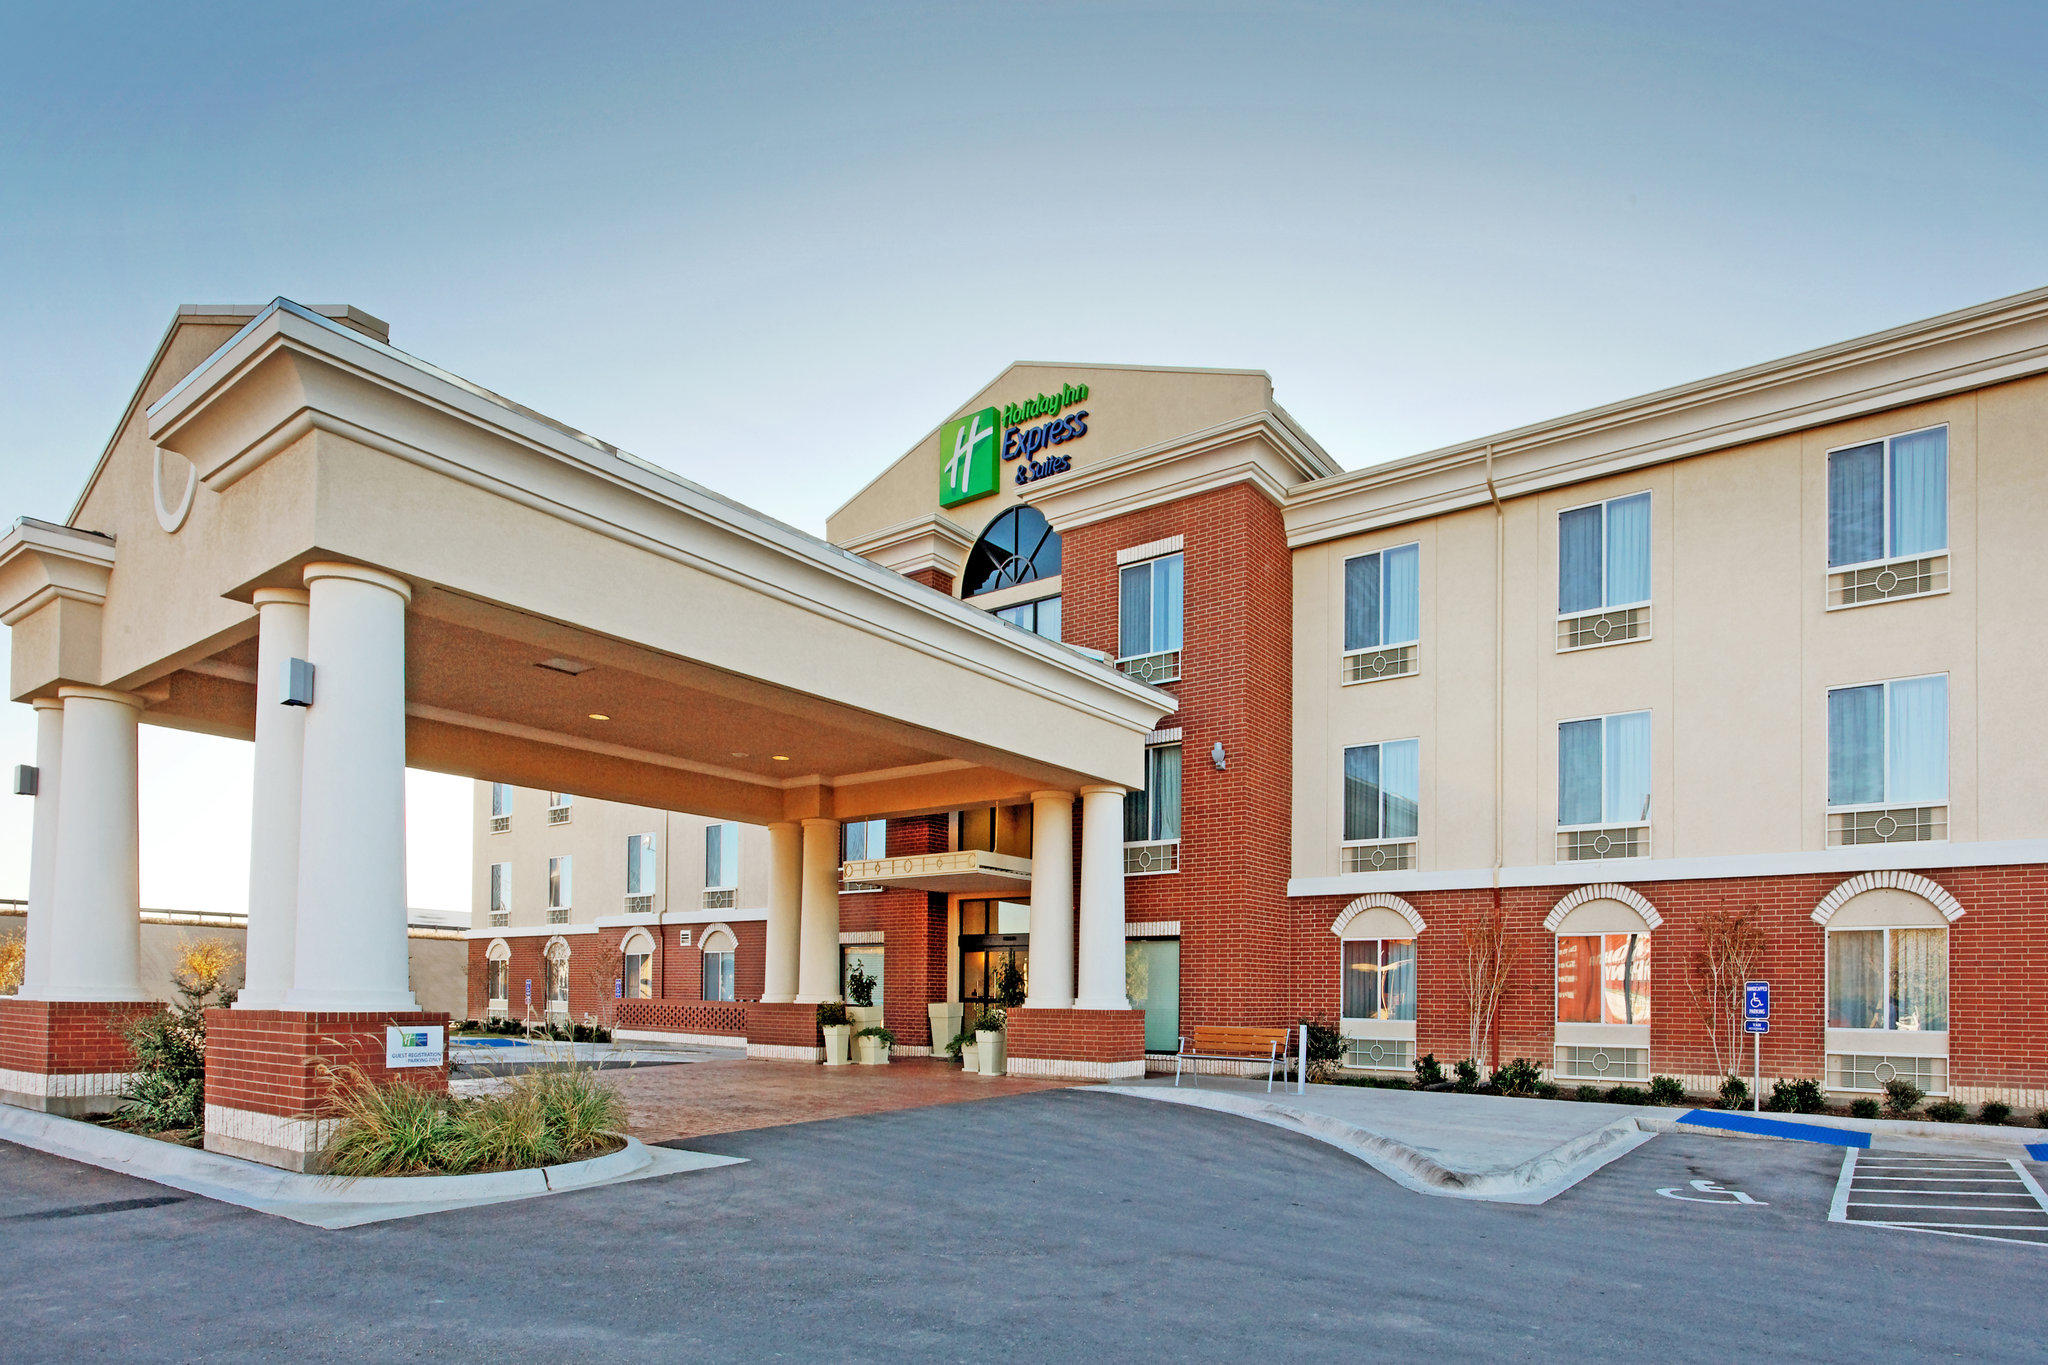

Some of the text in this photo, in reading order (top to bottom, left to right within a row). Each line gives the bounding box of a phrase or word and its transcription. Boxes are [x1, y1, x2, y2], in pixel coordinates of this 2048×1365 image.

[1002, 382, 1089, 428] Holiday Inn
[1002, 410, 1089, 462] Express
[1015, 454, 1072, 485] & Suites
